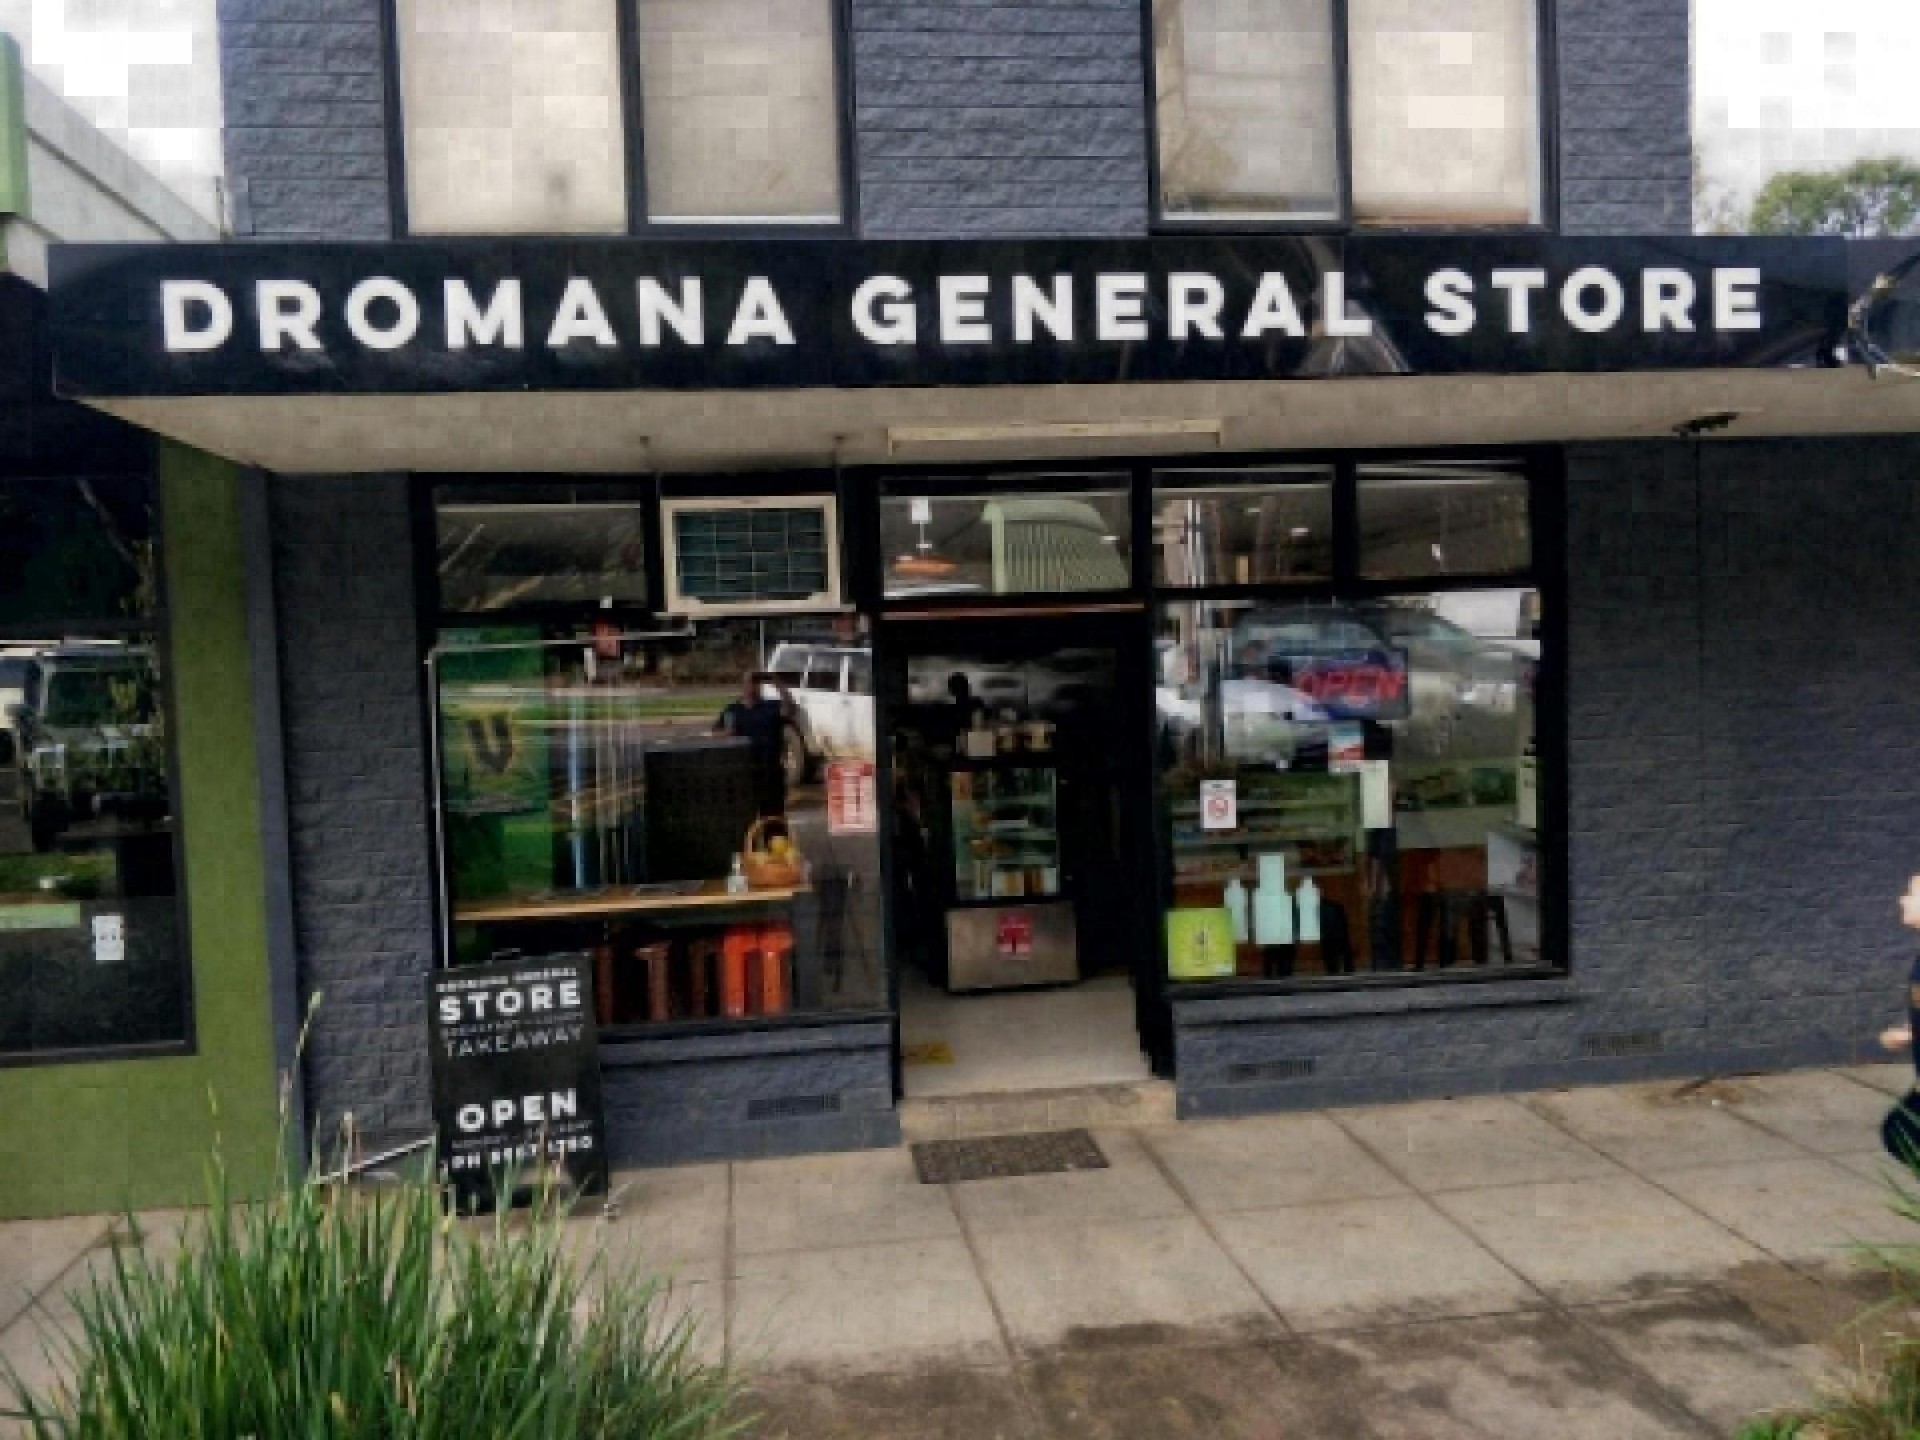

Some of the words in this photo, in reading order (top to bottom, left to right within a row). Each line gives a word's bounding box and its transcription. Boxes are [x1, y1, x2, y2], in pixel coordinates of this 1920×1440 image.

[160, 275, 796, 353] DROMANA
[851, 268, 1373, 345] GENERAL
[1423, 266, 1761, 336] STORE
[438, 980, 581, 1024] STORE
[457, 1089, 577, 1132] OPEN
